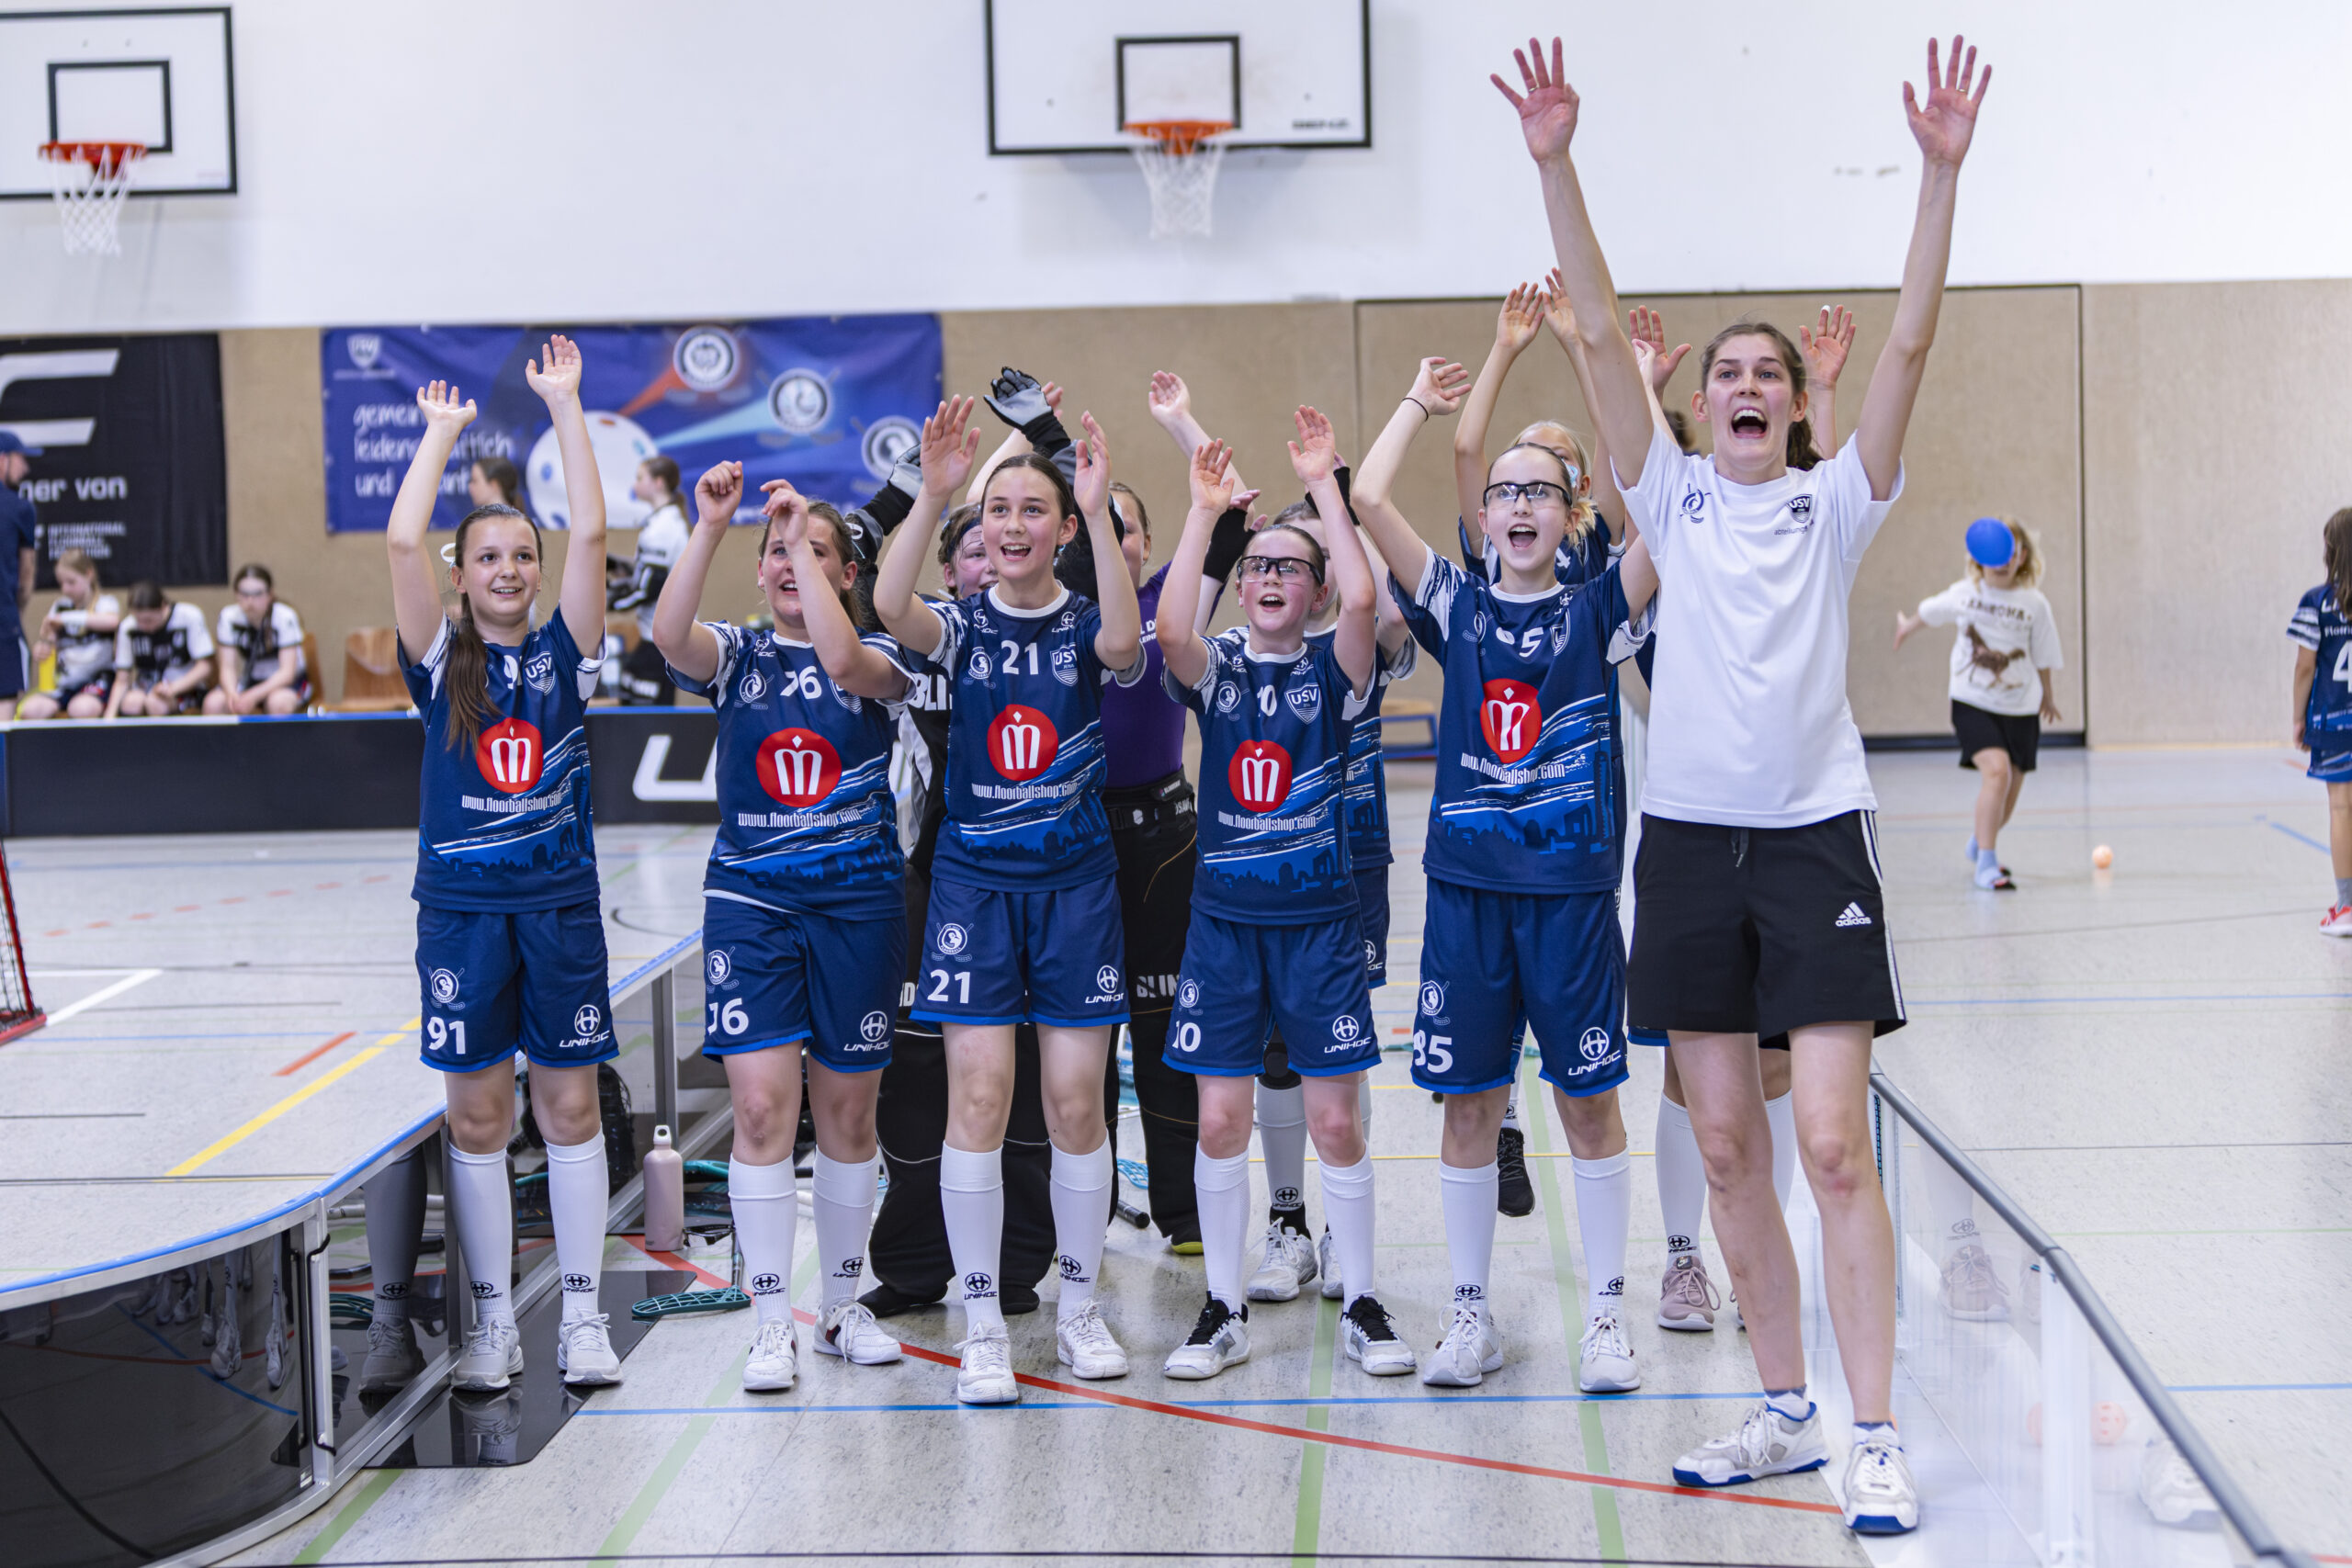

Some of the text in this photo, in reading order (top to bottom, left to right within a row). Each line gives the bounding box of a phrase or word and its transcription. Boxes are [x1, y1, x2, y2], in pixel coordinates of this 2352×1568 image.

[74, 475, 128, 501] von
[356, 467, 395, 497] und
[1789, 497, 1810, 509] USV
[525, 656, 552, 679] USV
[1001, 639, 1041, 675] 21
[780, 665, 822, 699] 76
[1290, 687, 1317, 705] USV
[738, 808, 862, 828] www.floorballshop.com
[1217, 810, 1317, 832] www.floorballshop.com
[1835, 916, 1872, 928] adidas
[926, 969, 971, 1004] 21
[426, 1016, 466, 1055] 91
[559, 1030, 611, 1048] UNIHOC
[1324, 1036, 1373, 1054] UNIHOC
[1567, 1049, 1623, 1077] UNIHOC
[965, 1291, 998, 1301] UNIHOC
